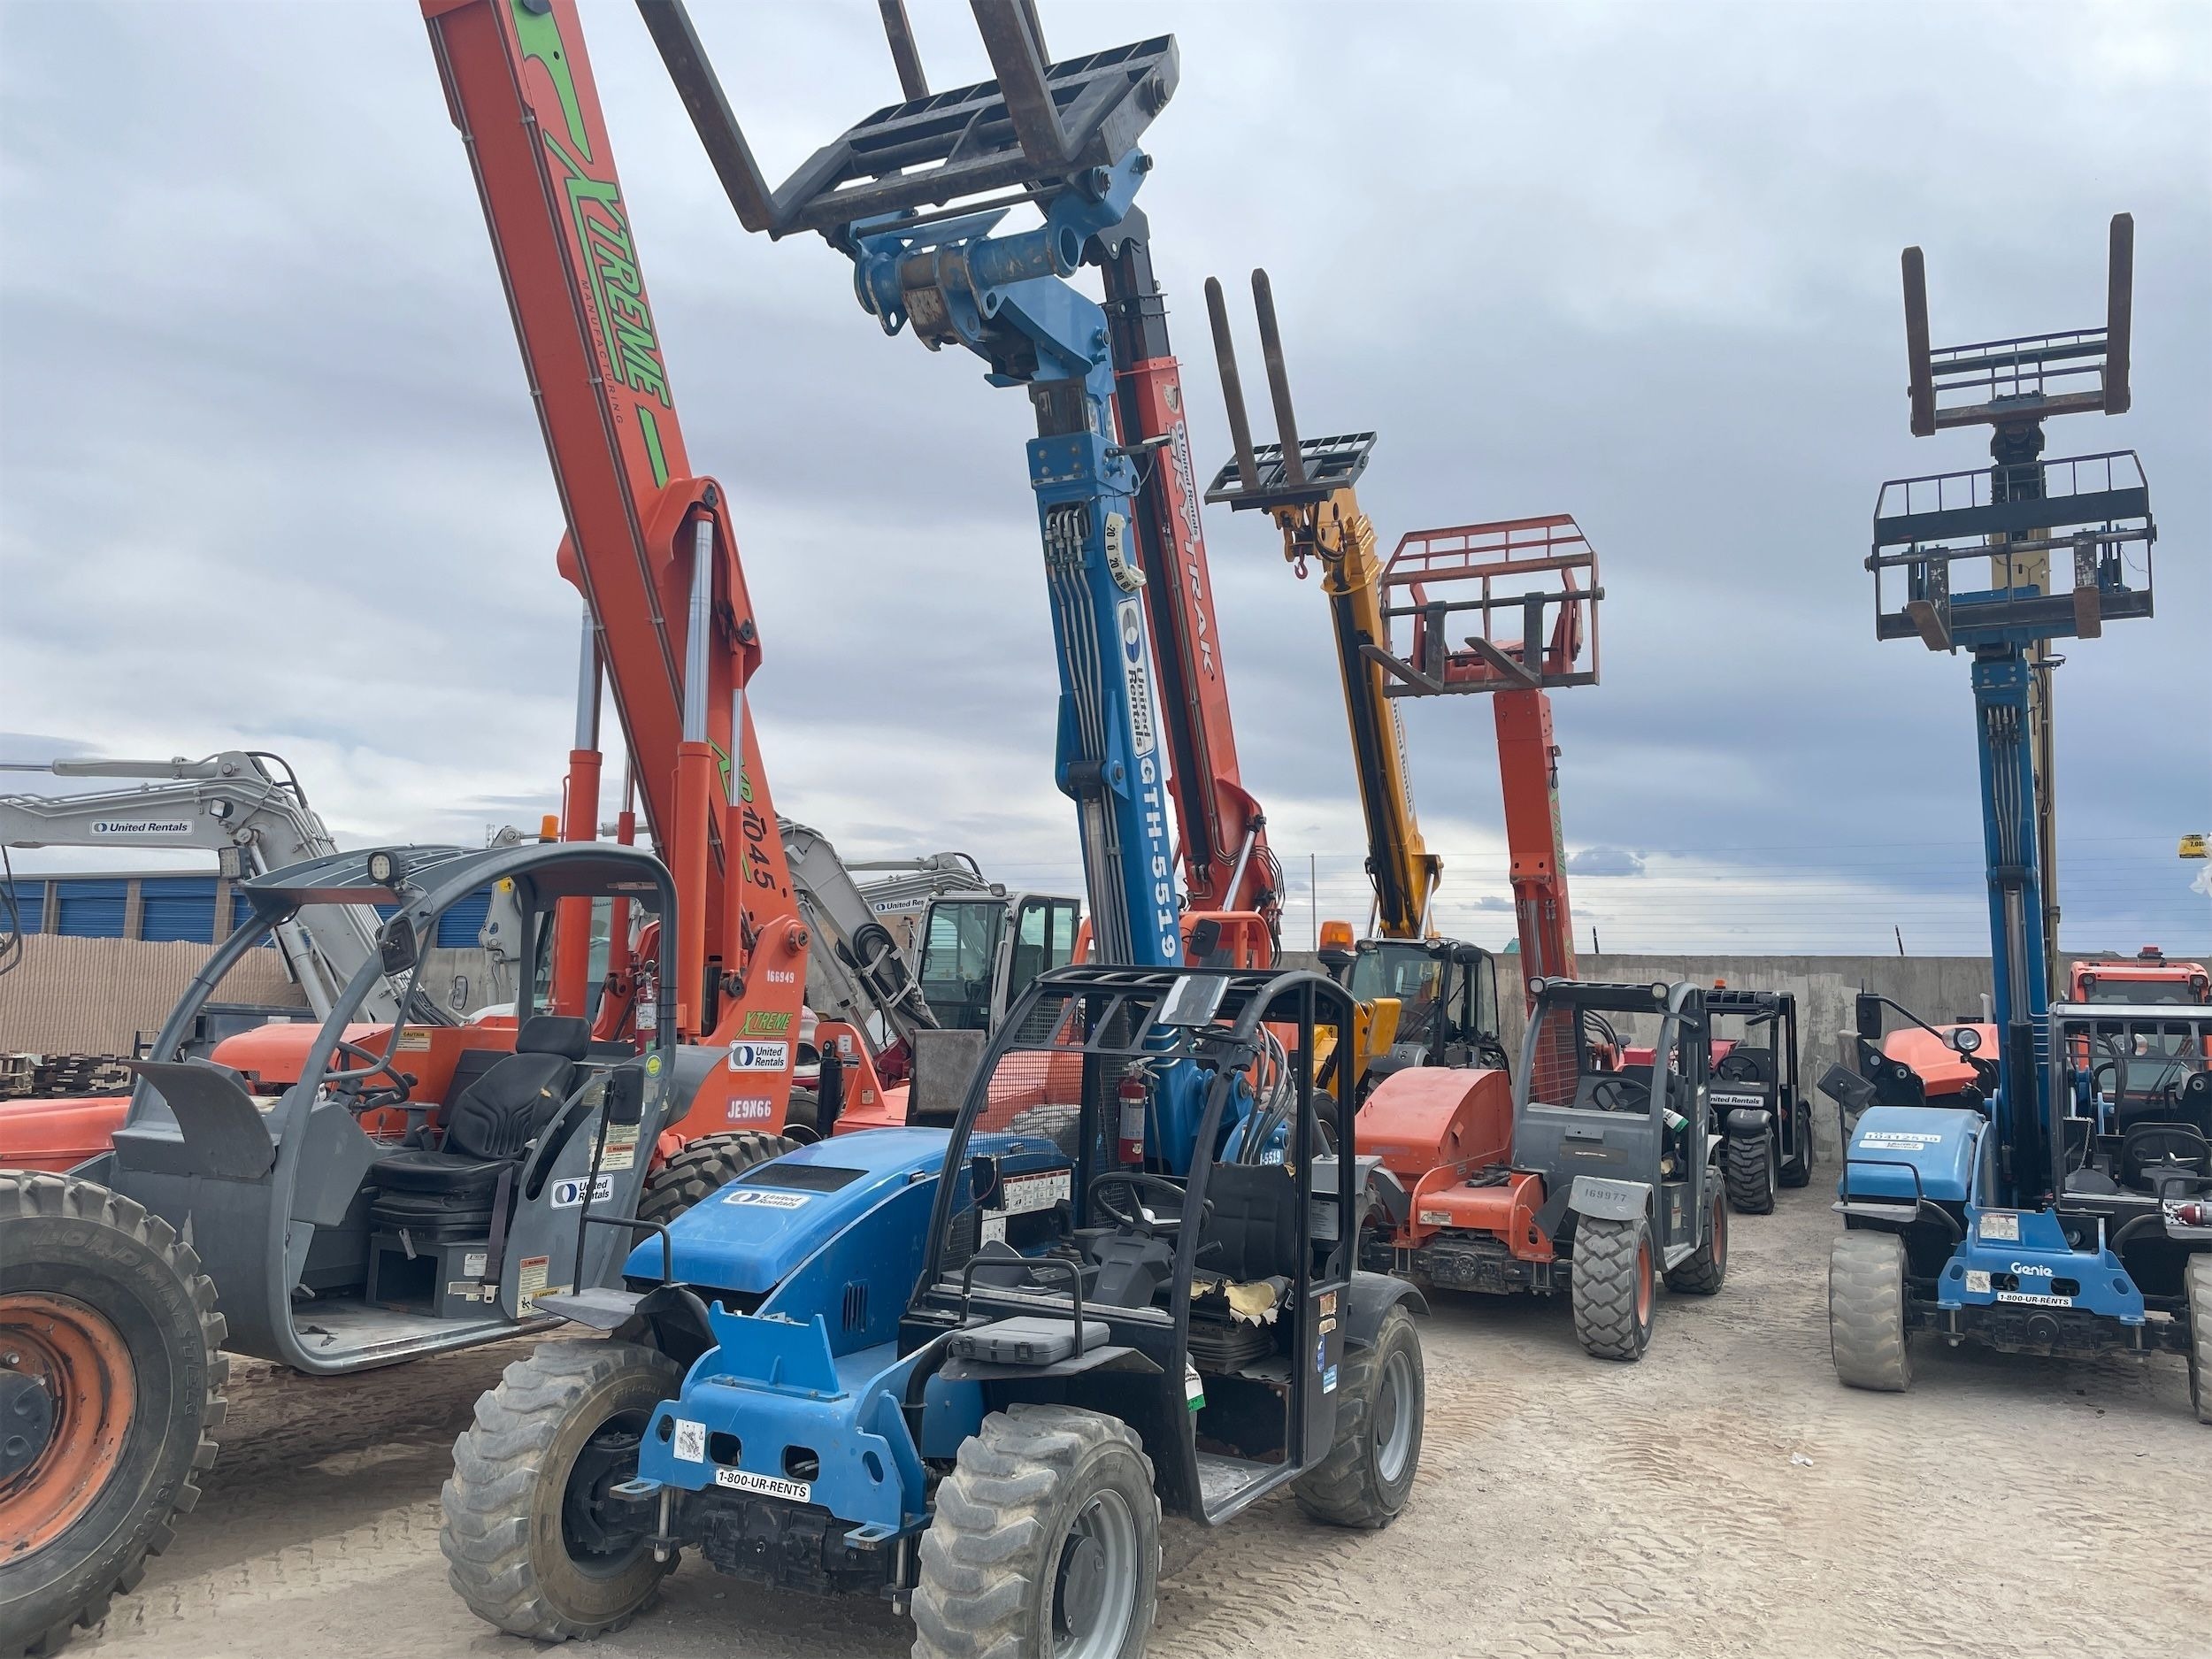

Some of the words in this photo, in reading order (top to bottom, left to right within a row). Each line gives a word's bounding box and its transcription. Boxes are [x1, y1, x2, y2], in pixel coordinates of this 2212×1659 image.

[542, 129, 672, 410] XTREME
[580, 278, 623, 425] MANUFACTURING
[1180, 442, 1192, 487] United
[1187, 489, 1199, 536] Rentals
[1107, 524, 1116, 537] -20
[1110, 557, 1119, 569] 20
[1115, 572, 1125, 581] 40
[1128, 669, 1143, 748] Rentals
[1137, 667, 1151, 738] United
[1401, 753, 1413, 813] Rentals
[110, 823, 147, 832] United
[148, 822, 188, 832] Rentals
[1140, 757, 1176, 958] GTH-5519
[887, 900, 911, 910] United
[767, 970, 795, 984] 166949
[735, 1011, 794, 1039] XTREME
[756, 1046, 783, 1057] United
[755, 1056, 785, 1067] Rentals
[727, 1100, 772, 1119] JE9N66
[1585, 1188, 1628, 1202] 169977
[2010, 1261, 2053, 1278] Genie
[2000, 1294, 2070, 1306] 1-800-UR-RENTS
[718, 1471, 808, 1497] 1-800-UR-RENTS
